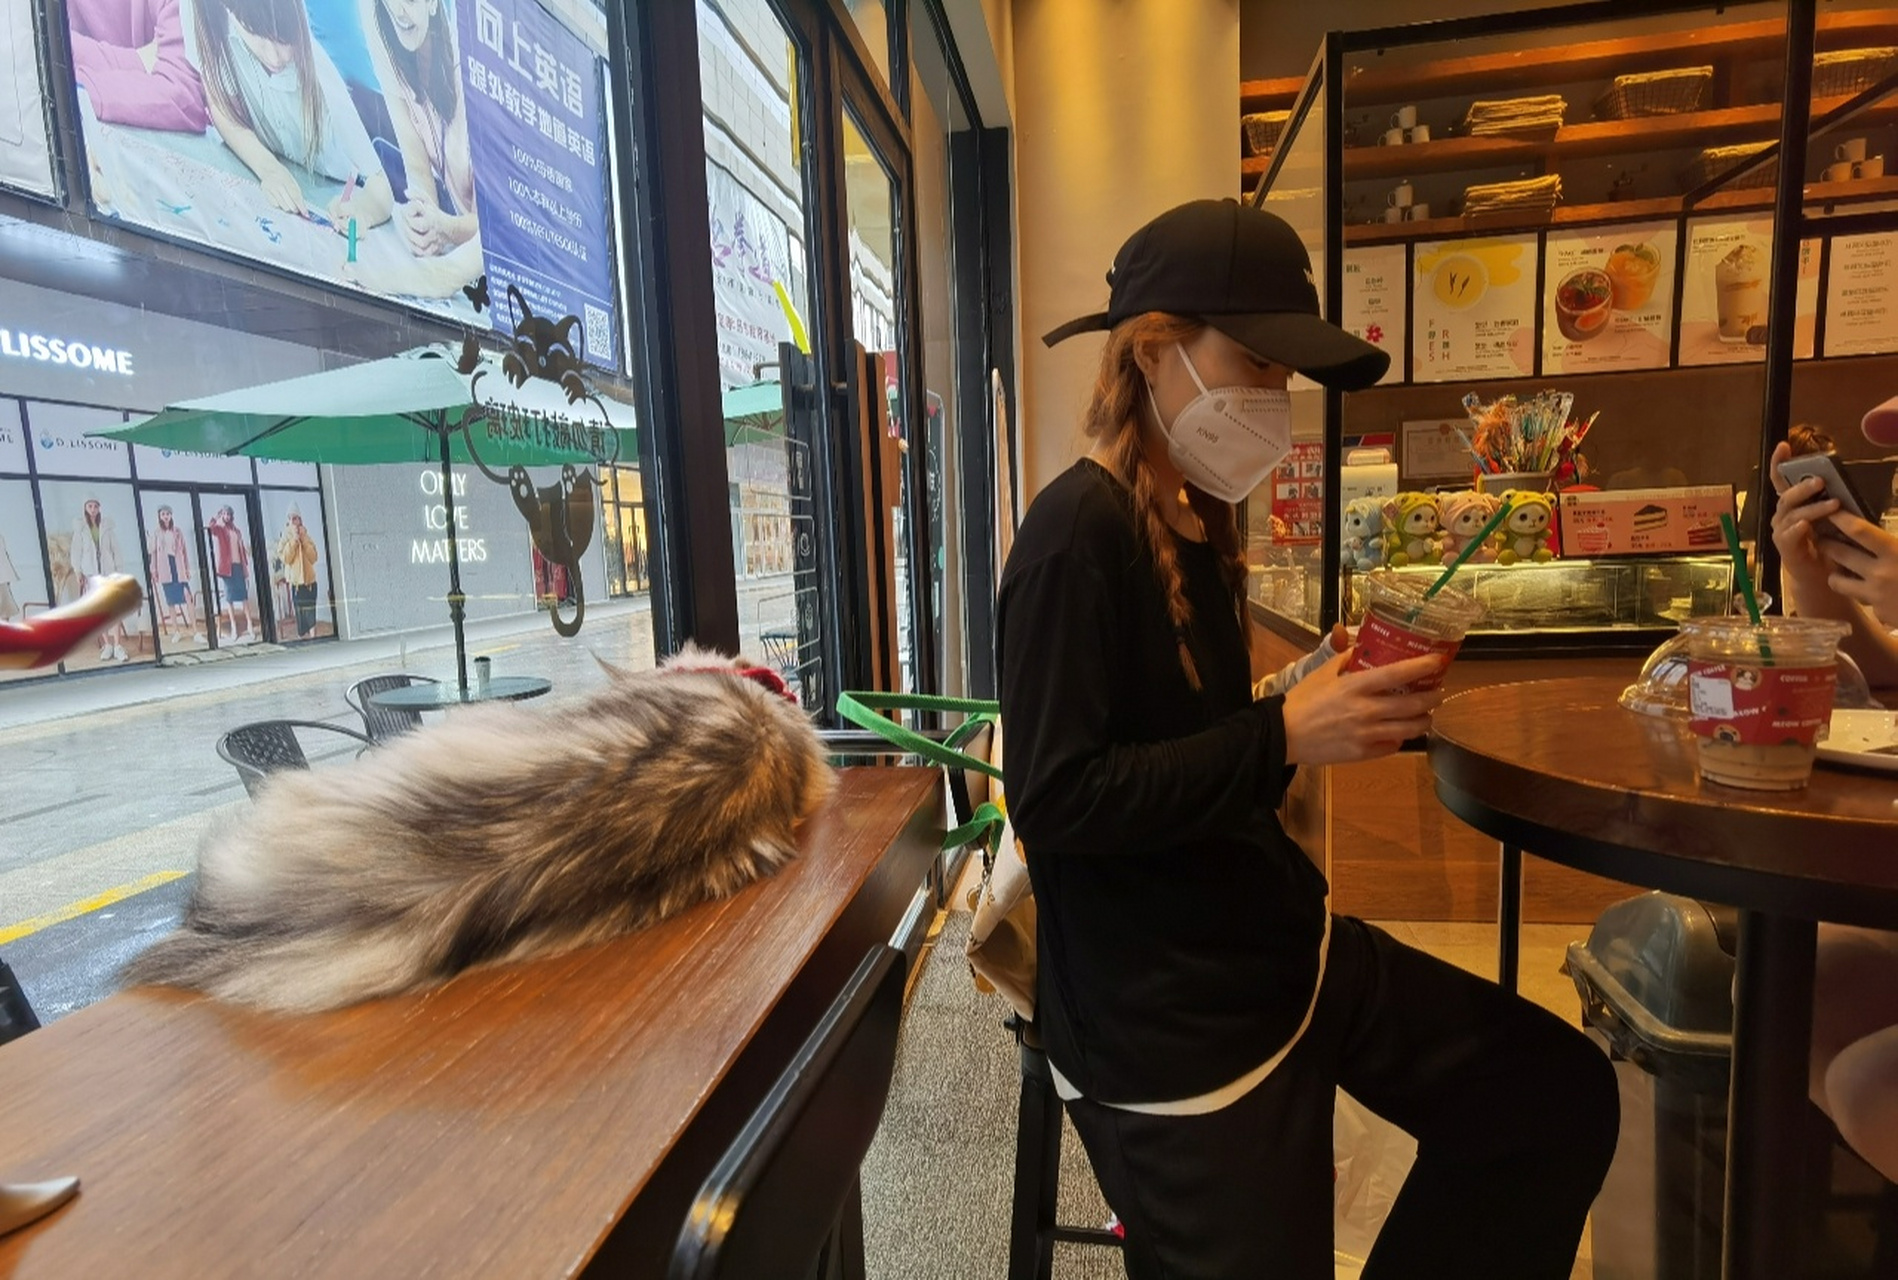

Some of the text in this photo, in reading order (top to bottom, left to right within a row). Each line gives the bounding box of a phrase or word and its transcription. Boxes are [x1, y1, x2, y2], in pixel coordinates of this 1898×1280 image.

[475, 0, 584, 119] 向上英语
[467, 55, 596, 167] 跟外教学地道英语
[0, 328, 134, 375] LISSOME
[1196, 426, 1220, 443] KN95
